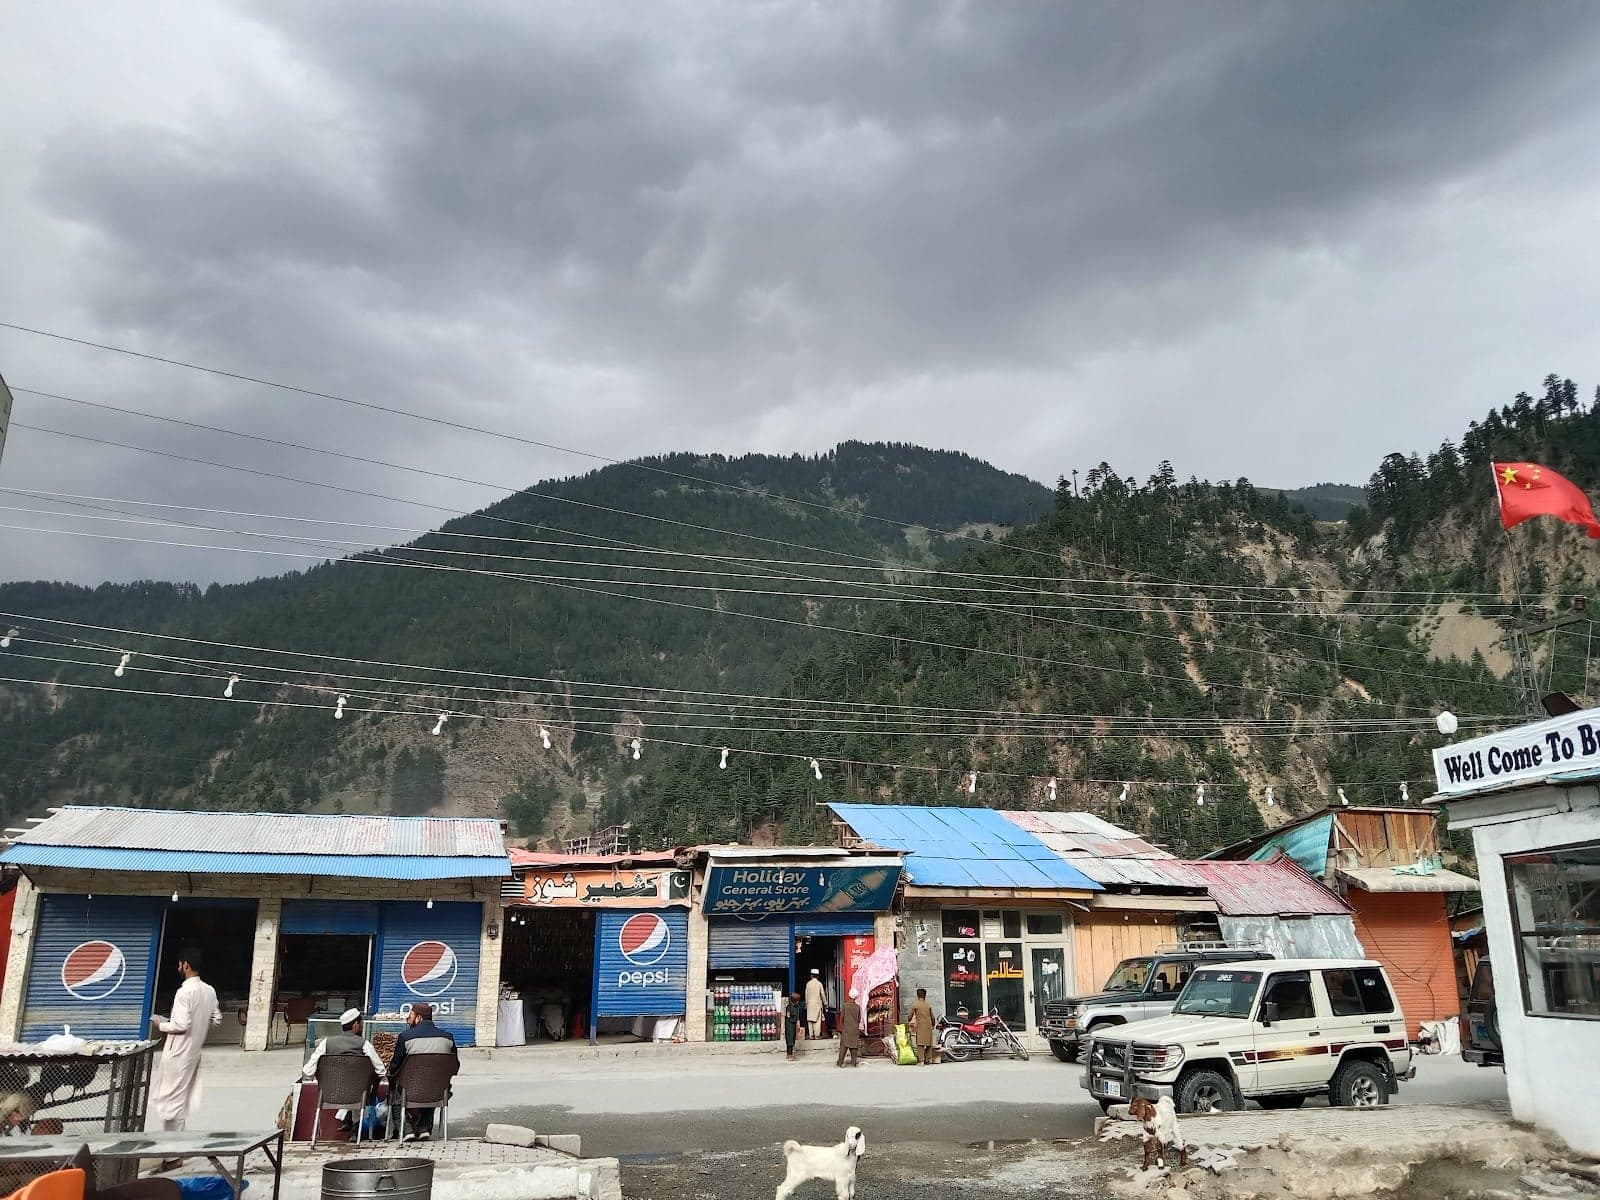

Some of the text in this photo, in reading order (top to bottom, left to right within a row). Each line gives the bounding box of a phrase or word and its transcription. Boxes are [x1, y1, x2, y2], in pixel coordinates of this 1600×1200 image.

[1444, 750, 1485, 785] Well
[1488, 744, 1543, 775] Come
[1545, 731, 1574, 763] To
[733, 870, 807, 885] Holiday
[526, 873, 660, 904] کشمیر شوز
[722, 885, 810, 895] General Store
[618, 967, 669, 988] pepsi
